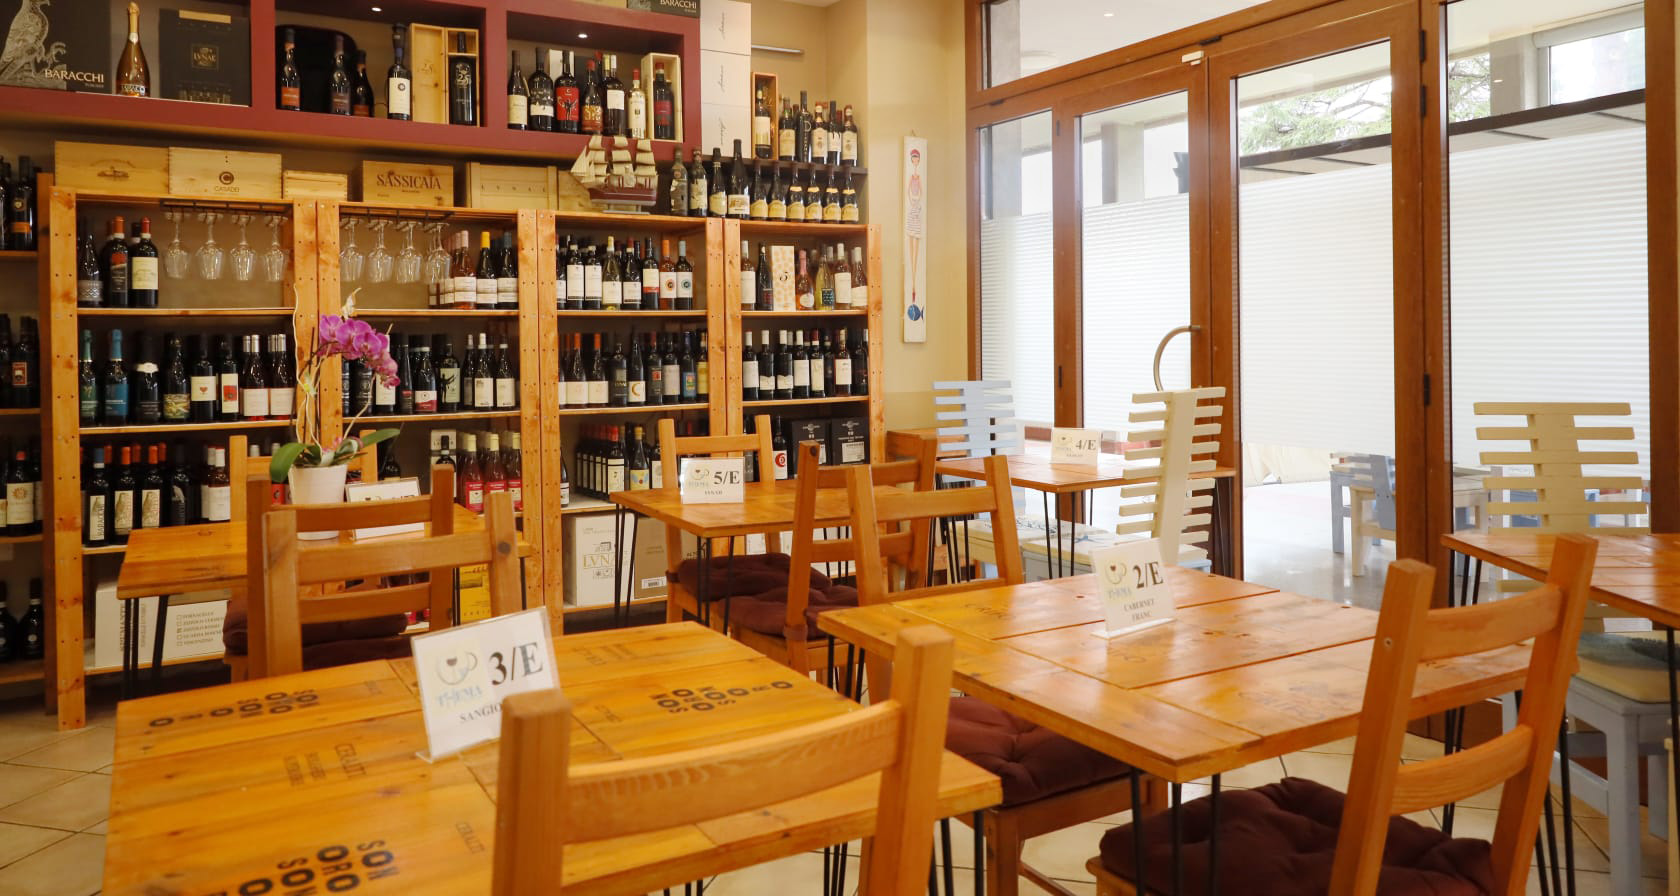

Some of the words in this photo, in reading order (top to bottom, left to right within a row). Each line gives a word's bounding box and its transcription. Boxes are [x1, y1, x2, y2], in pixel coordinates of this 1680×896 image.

[44, 68, 105, 83] BARACCHI
[376, 173, 442, 190] SASSICAIA
[1075, 439, 1096, 451] 4/E
[713, 471, 740, 485] 5/E
[1133, 561, 1164, 589] 2/E
[1123, 598, 1155, 612] CABERNET
[1131, 610, 1152, 622] FRANC
[489, 642, 543, 686] 3/E
[459, 702, 502, 723] SANGIO
